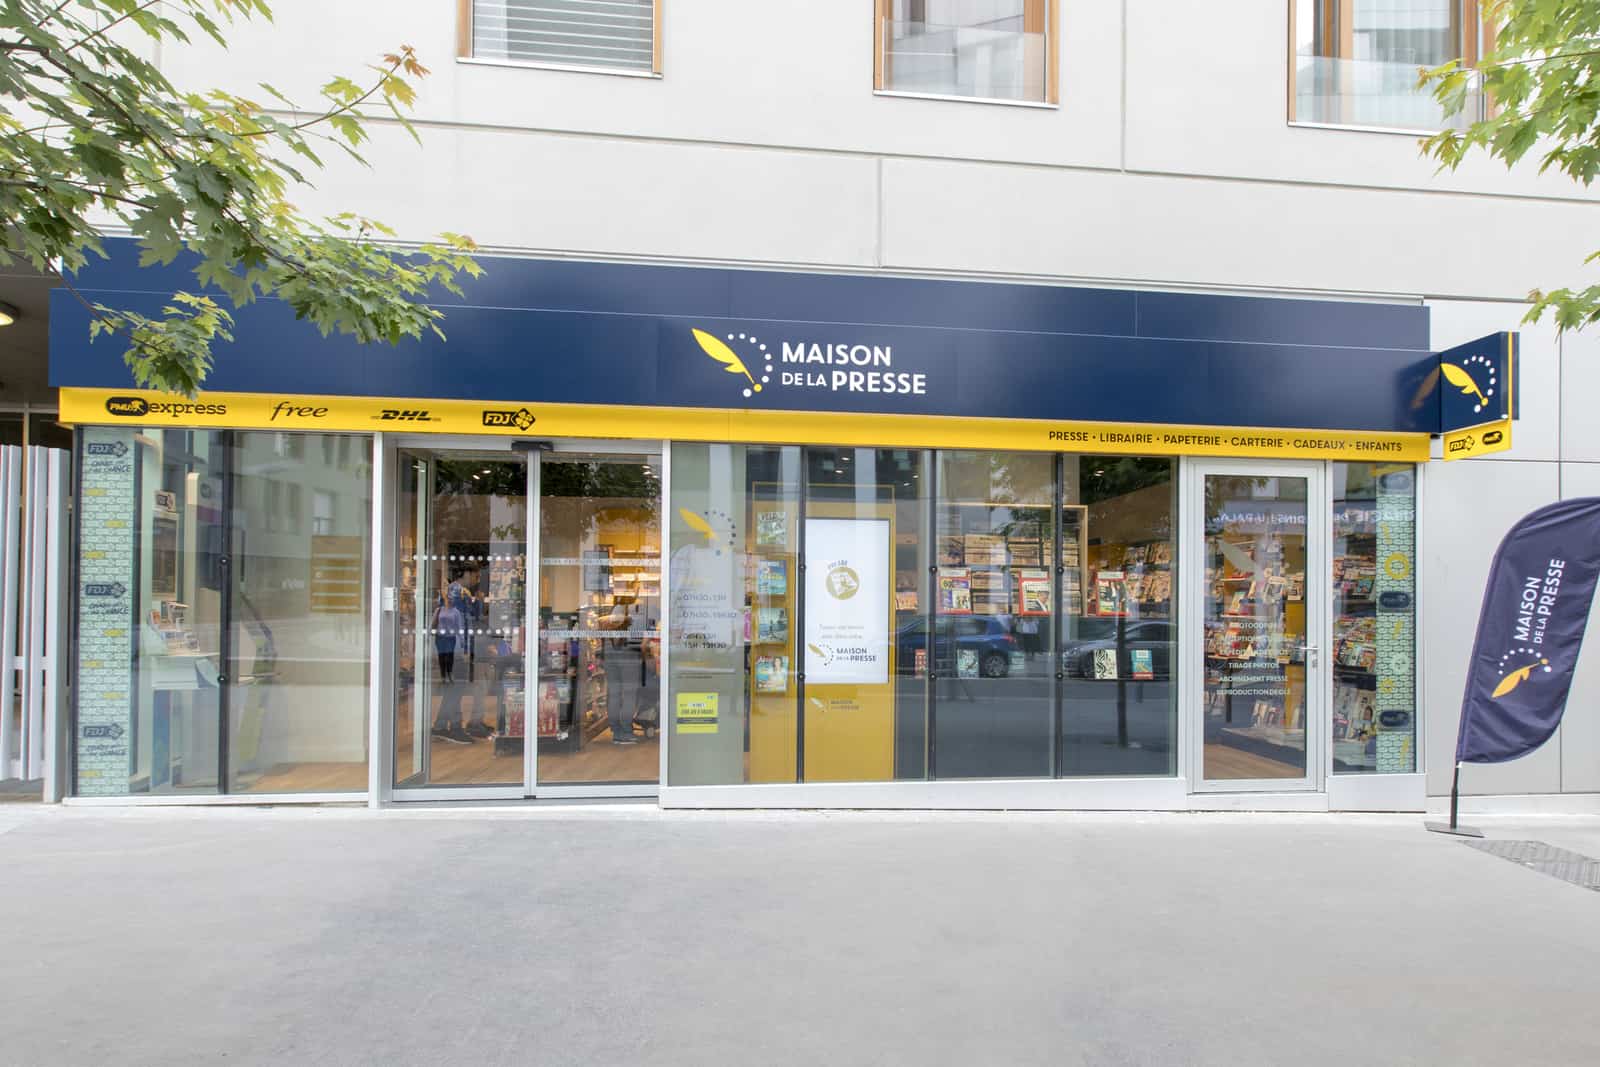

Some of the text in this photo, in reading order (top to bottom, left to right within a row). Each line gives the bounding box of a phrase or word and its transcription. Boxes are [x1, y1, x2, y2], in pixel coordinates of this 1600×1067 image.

[782, 342, 892, 367] MAISON
[782, 370, 926, 394] DE LA PRESSE
[149, 401, 227, 418] express
[270, 401, 329, 422] free
[381, 409, 431, 421] DHL
[484, 412, 511, 425] FDJ
[1049, 430, 1403, 452] PRESSE LIBRAIRIE PAPETERIE CARTERIE CADEAUX ENFANTS
[1513, 577, 1542, 641] MAISON
[1533, 559, 1566, 643] DE LA PRESSE
[836, 647, 868, 655] MAISON
[850, 654, 877, 662] PRESSE
